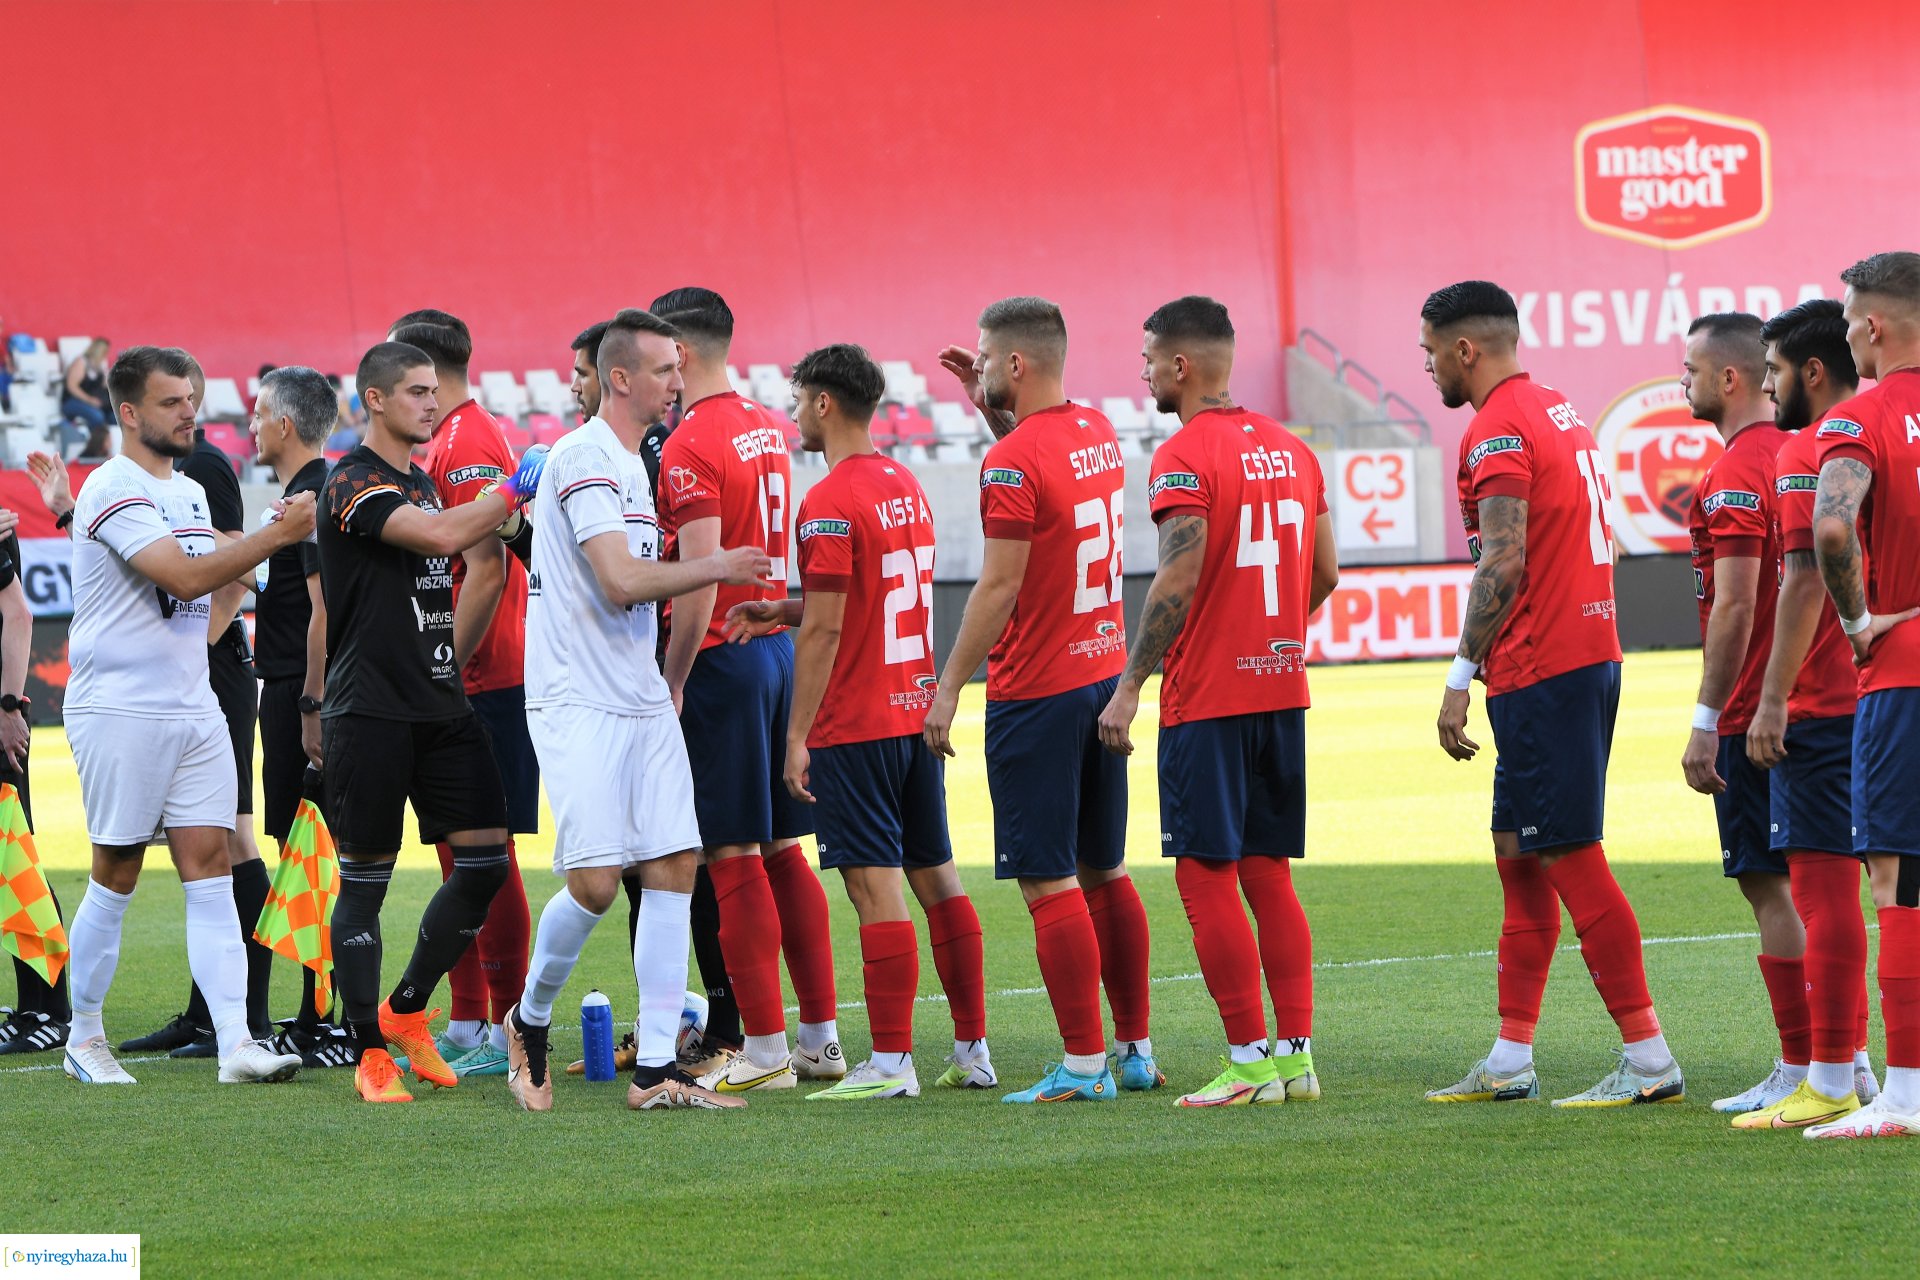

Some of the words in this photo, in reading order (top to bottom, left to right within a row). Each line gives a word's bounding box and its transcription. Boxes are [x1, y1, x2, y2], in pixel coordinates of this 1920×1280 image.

[1597, 135, 1747, 177] master
[1620, 168, 1726, 222] good
[1510, 272, 1829, 348] KISVÁRD
[1904, 412, 1920, 444] A
[1240, 445, 1297, 481] CSŐSZ
[1344, 455, 1405, 501] C3
[874, 497, 916, 531] KISS
[1073, 487, 1124, 614] 28
[1236, 499, 1305, 617] 47
[1308, 583, 1472, 644] PMI
